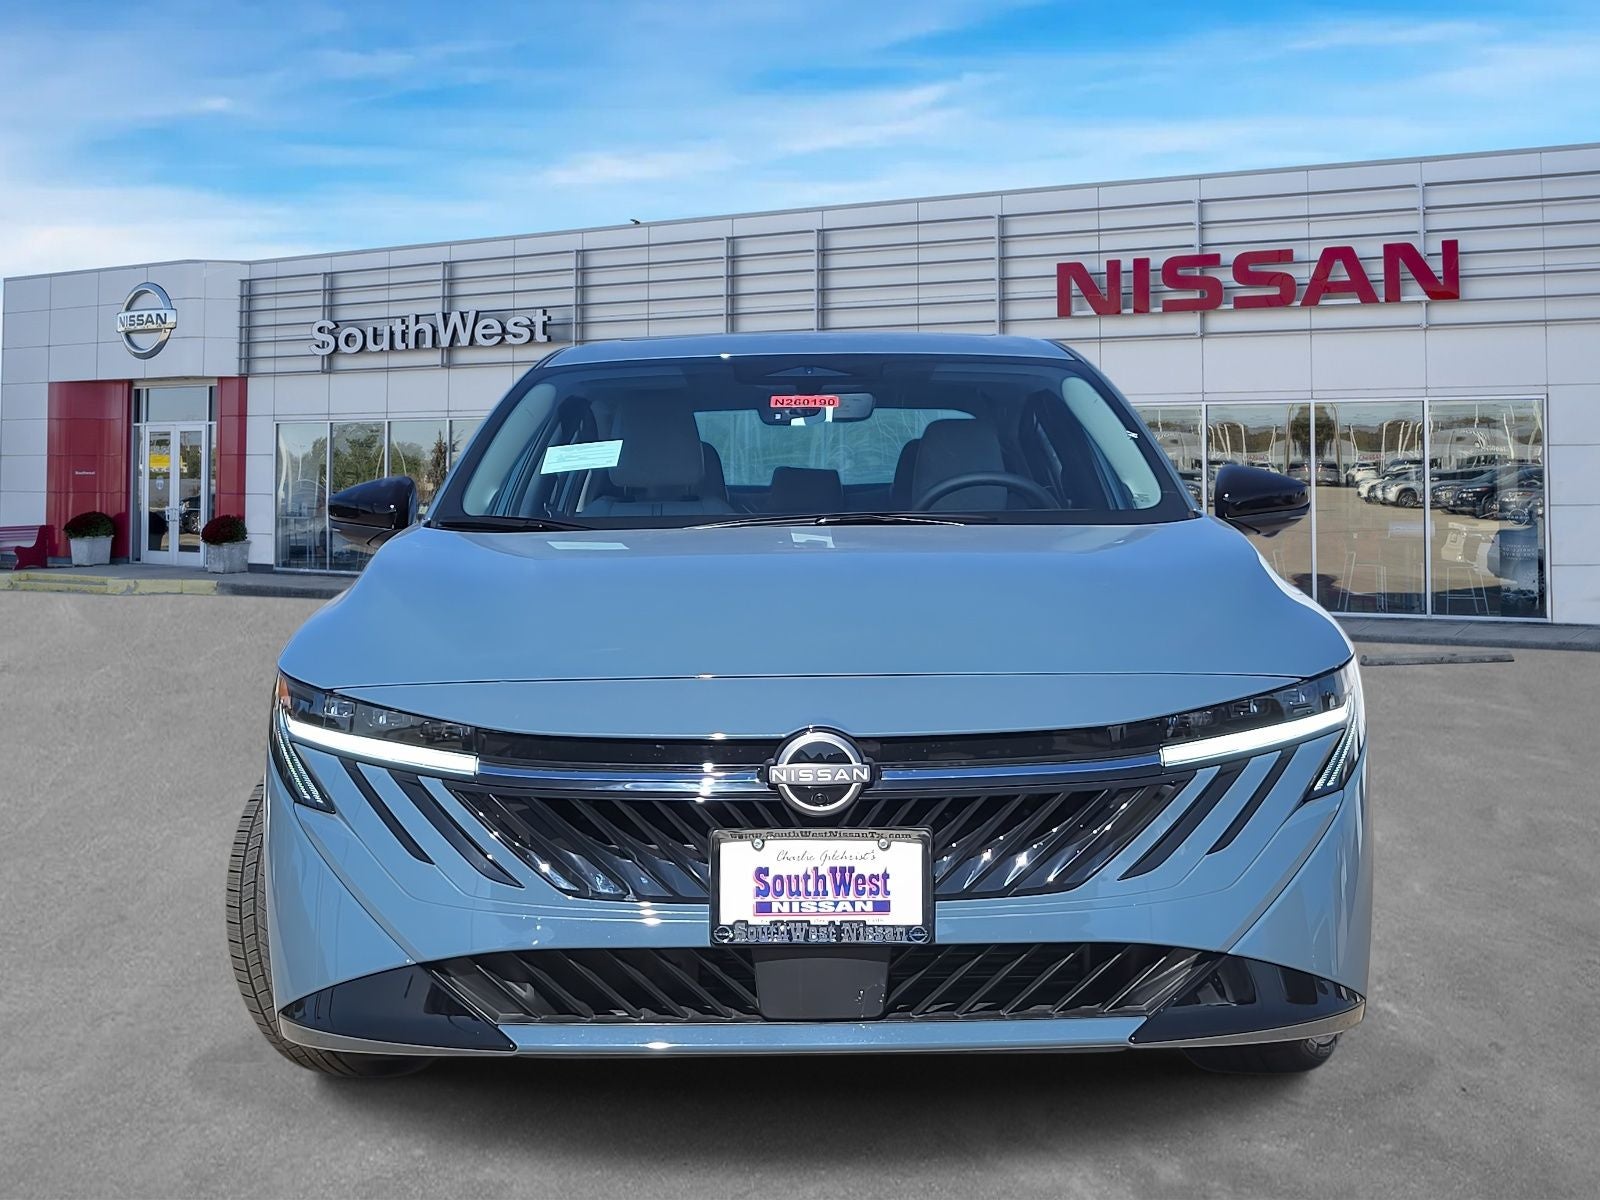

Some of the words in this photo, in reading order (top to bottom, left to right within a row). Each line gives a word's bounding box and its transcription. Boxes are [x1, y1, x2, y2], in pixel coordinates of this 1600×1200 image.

[1056, 239, 1460, 317] NISSAN
[118, 312, 167, 328] NISSAN
[309, 309, 551, 356] SouthWest
[774, 398, 836, 406] N260190
[771, 767, 869, 783] NISSAN
[753, 866, 891, 899] SouthWest
[771, 900, 874, 913] NISSAN
[734, 921, 837, 942] SouthWest
[840, 921, 908, 942] Nissan
